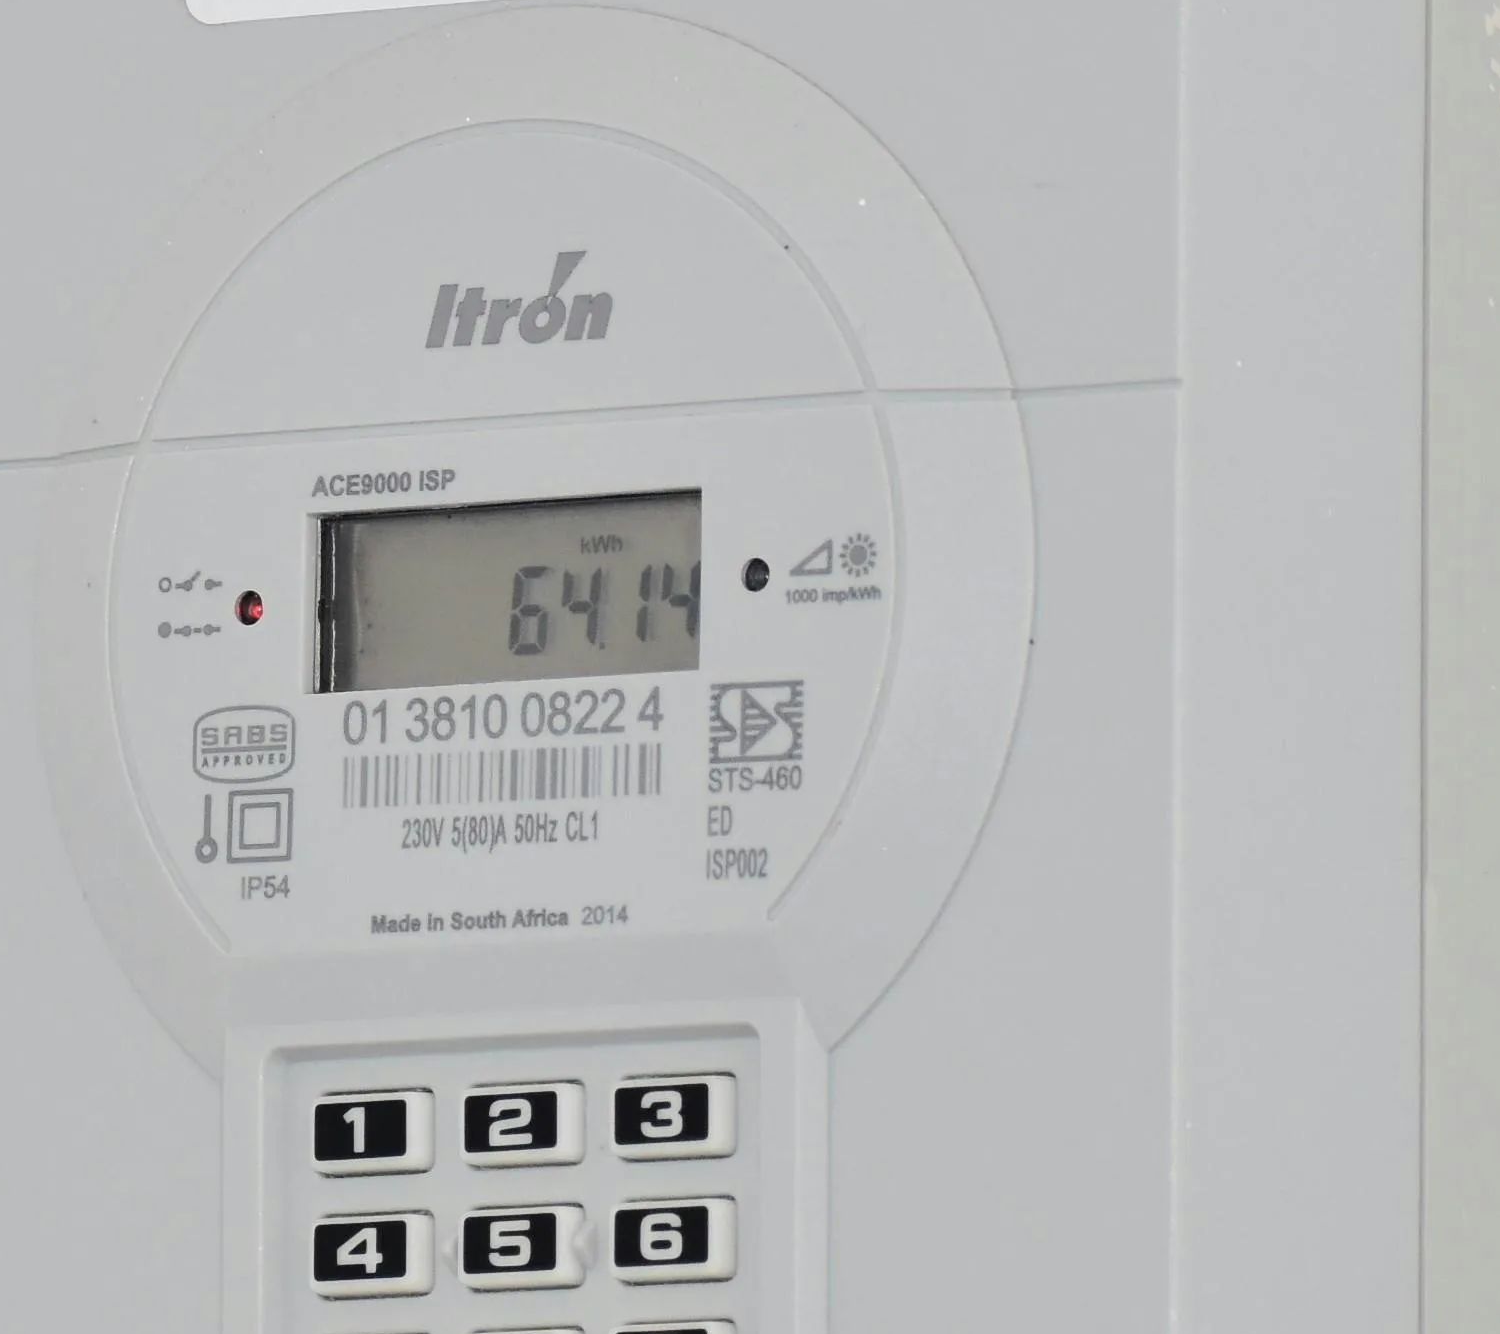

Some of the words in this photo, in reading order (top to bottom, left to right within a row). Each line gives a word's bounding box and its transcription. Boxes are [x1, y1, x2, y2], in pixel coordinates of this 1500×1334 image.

[311, 471, 413, 498] ACE9000
[419, 468, 456, 492] ISP
[580, 534, 625, 555] kWh
[785, 589, 818, 604] 1000
[822, 586, 882, 606] imp/kWh
[343, 698, 387, 745] 01
[404, 693, 508, 742] 3810
[520, 687, 626, 737] 0822
[636, 685, 664, 731] 4
[201, 723, 288, 747] SABS
[201, 753, 286, 769] APPROVED
[708, 764, 802, 793] STS-460
[401, 817, 445, 849] 230V
[450, 814, 507, 854] 5(80)A
[513, 812, 558, 844] 50Hz
[565, 809, 599, 842] CL1
[707, 805, 733, 837] ED
[706, 847, 768, 880] ISP002
[240, 874, 291, 900] IP54
[370, 913, 421, 934] Made
[426, 913, 445, 932] in
[450, 909, 507, 931] South
[511, 907, 569, 929] Africa
[581, 904, 629, 926] 2014
[343, 1107, 368, 1154] 1
[488, 1099, 533, 1147] 2
[640, 1090, 684, 1138] 3
[336, 1227, 384, 1274] 4
[489, 1219, 532, 1267] 5
[640, 1212, 684, 1260] 6
